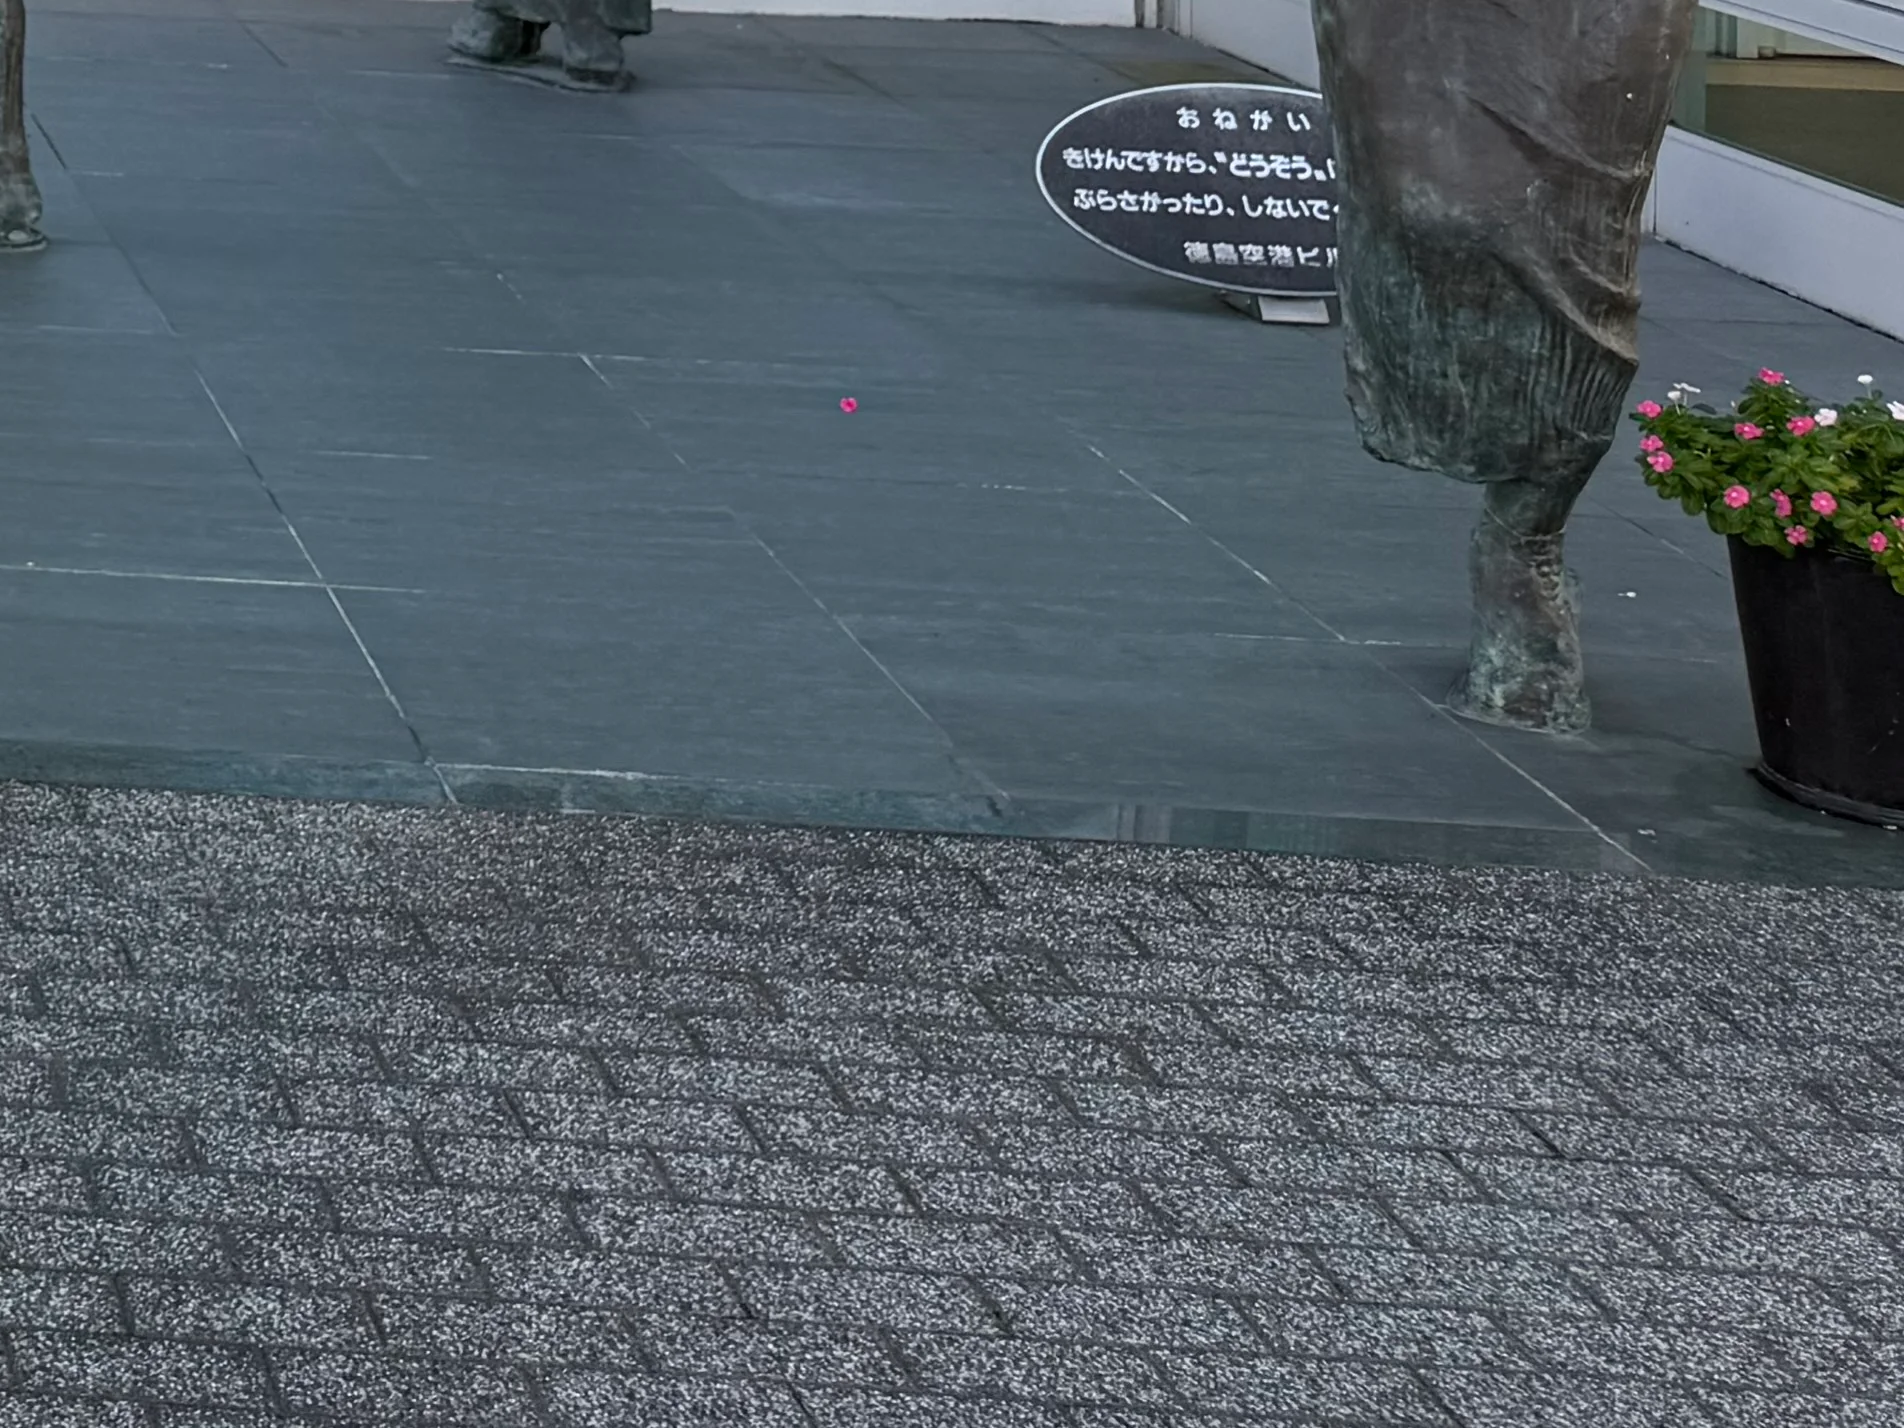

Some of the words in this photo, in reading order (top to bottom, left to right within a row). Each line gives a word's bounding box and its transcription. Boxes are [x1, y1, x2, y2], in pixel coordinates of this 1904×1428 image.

[1176, 106, 1312, 133] おねがい
[1073, 186, 1339, 222] ぶらさがったり、しないで
